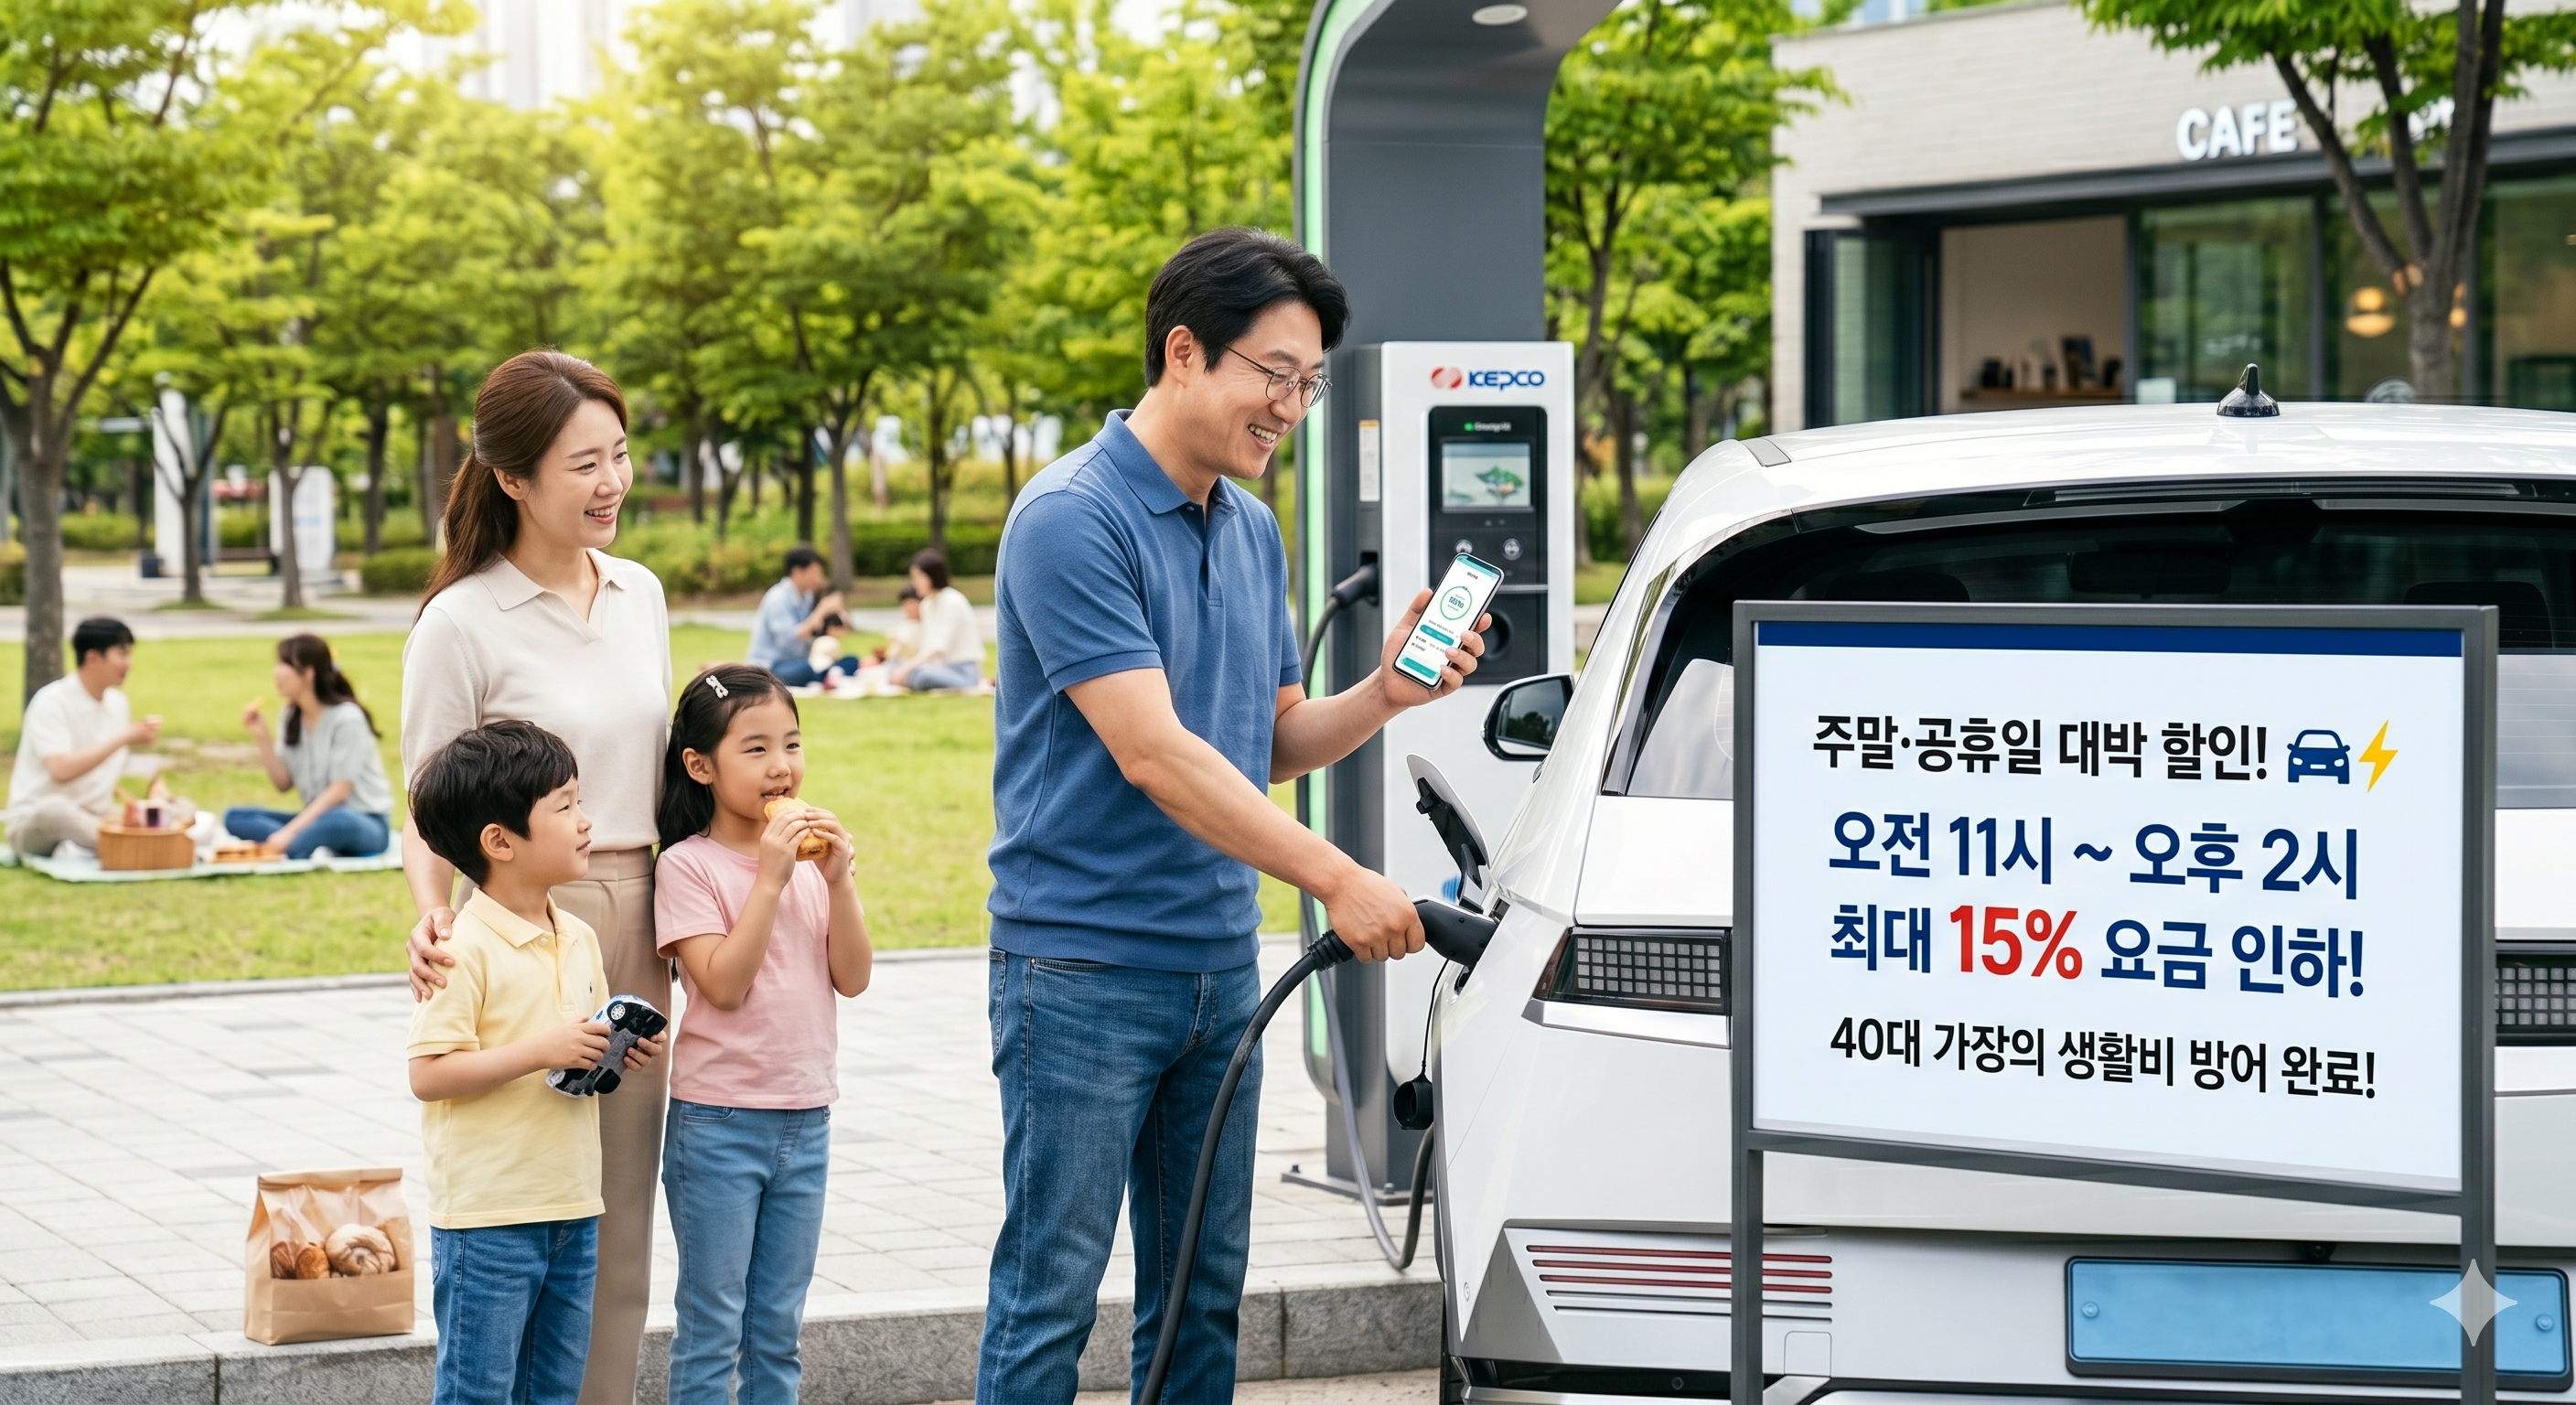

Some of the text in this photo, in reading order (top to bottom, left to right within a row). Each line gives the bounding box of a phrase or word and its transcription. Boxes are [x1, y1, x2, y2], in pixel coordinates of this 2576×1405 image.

[2176, 99, 2298, 161] CAFE
[1468, 370, 1545, 391] KEPCO
[1813, 714, 2268, 781] 주말·공휴일 대박 할인!
[1829, 810, 1931, 878] 오전
[1949, 816, 2052, 885] 11시
[2129, 822, 2243, 894] 오후
[2261, 828, 2357, 900] 2시
[1830, 904, 2364, 999] 최대 15% 요금 인하!
[1830, 1016, 2376, 1099] 40대 가장의 생활비 방어 완료!
